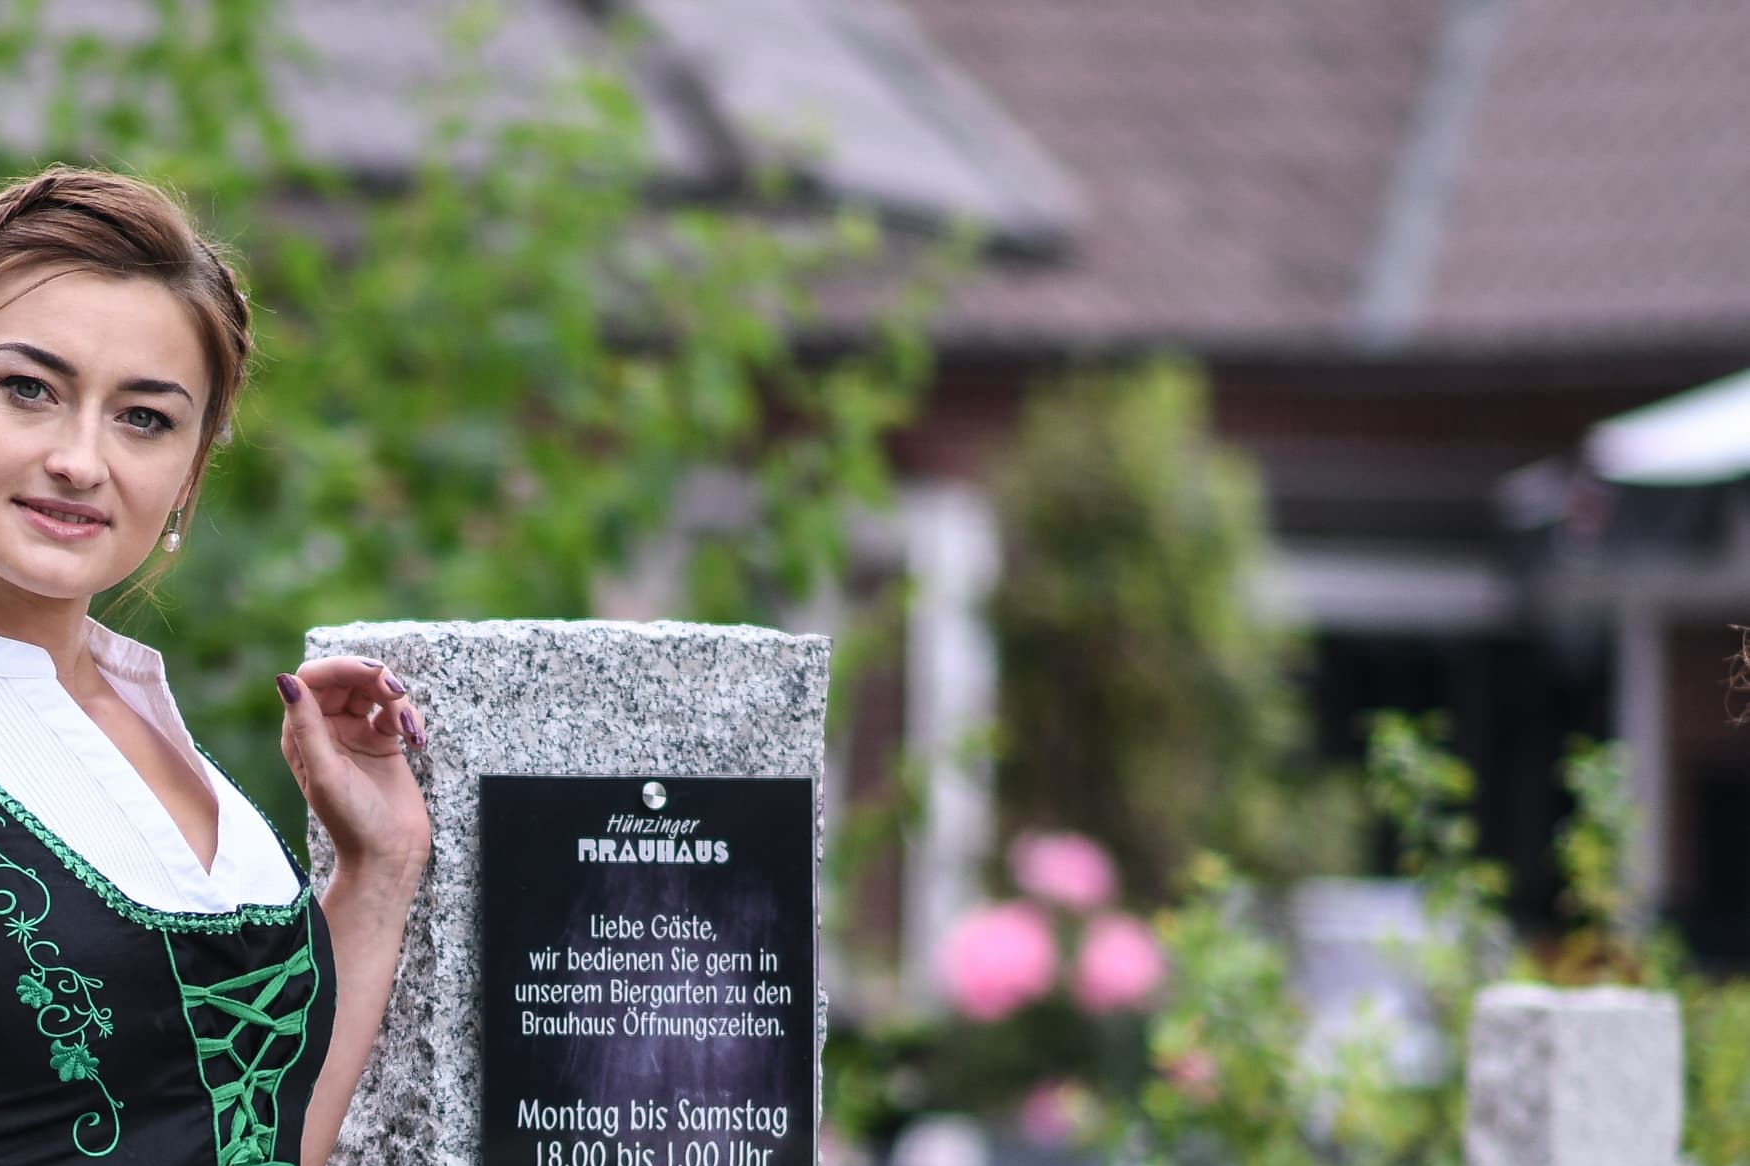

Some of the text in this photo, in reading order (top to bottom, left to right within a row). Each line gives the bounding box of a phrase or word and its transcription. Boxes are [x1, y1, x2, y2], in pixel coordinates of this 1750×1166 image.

[607, 814, 700, 839] Hünzinger
[578, 838, 729, 863] BRAUHAUS
[590, 914, 718, 941] Liebe Gäste,
[529, 947, 778, 976] wir bedienen Sie gern in
[515, 979, 791, 1008] unserem Biergarten zu den
[521, 1007, 785, 1041] Brauhaus Öffnungszeiten.
[517, 1099, 788, 1137] Montag bis Samstag
